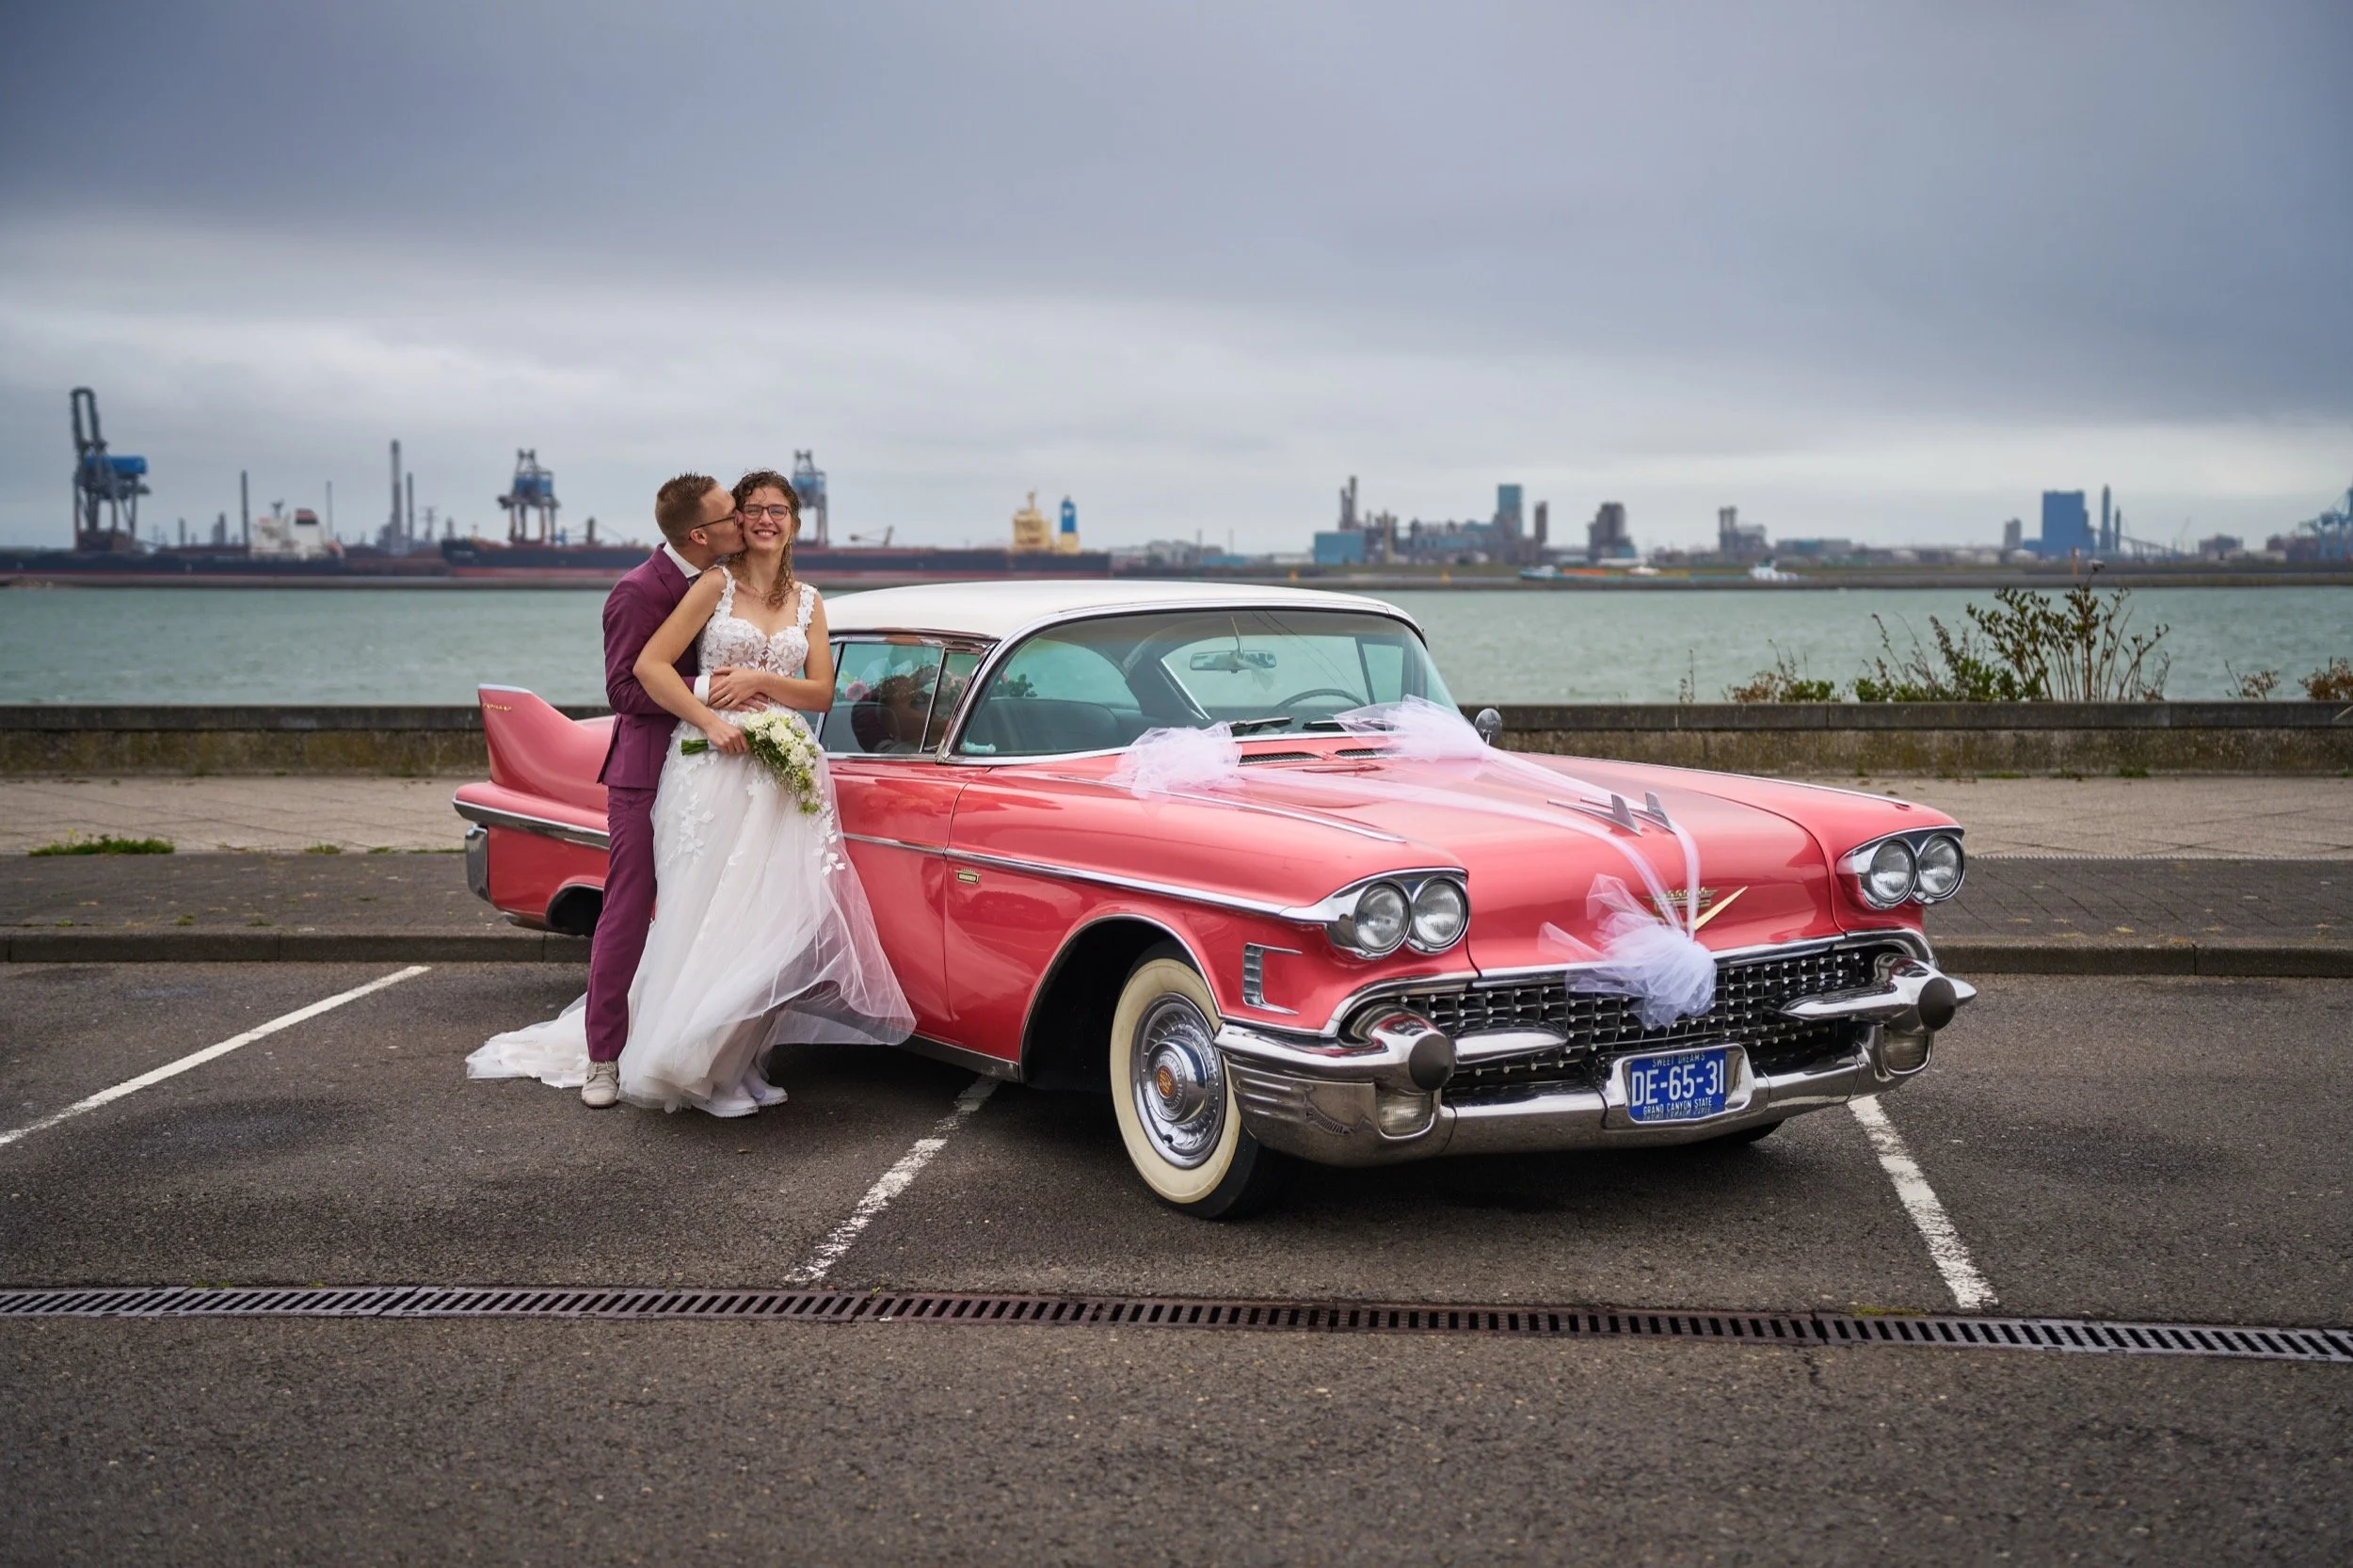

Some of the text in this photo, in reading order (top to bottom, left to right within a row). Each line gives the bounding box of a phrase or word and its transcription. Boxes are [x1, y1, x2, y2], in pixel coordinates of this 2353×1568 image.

[1652, 1052, 1705, 1067] SWEET DREAMS
[1631, 1060, 1724, 1107] DE-65-31
[1642, 1096, 1713, 1115] GRAND CANYON STATE
